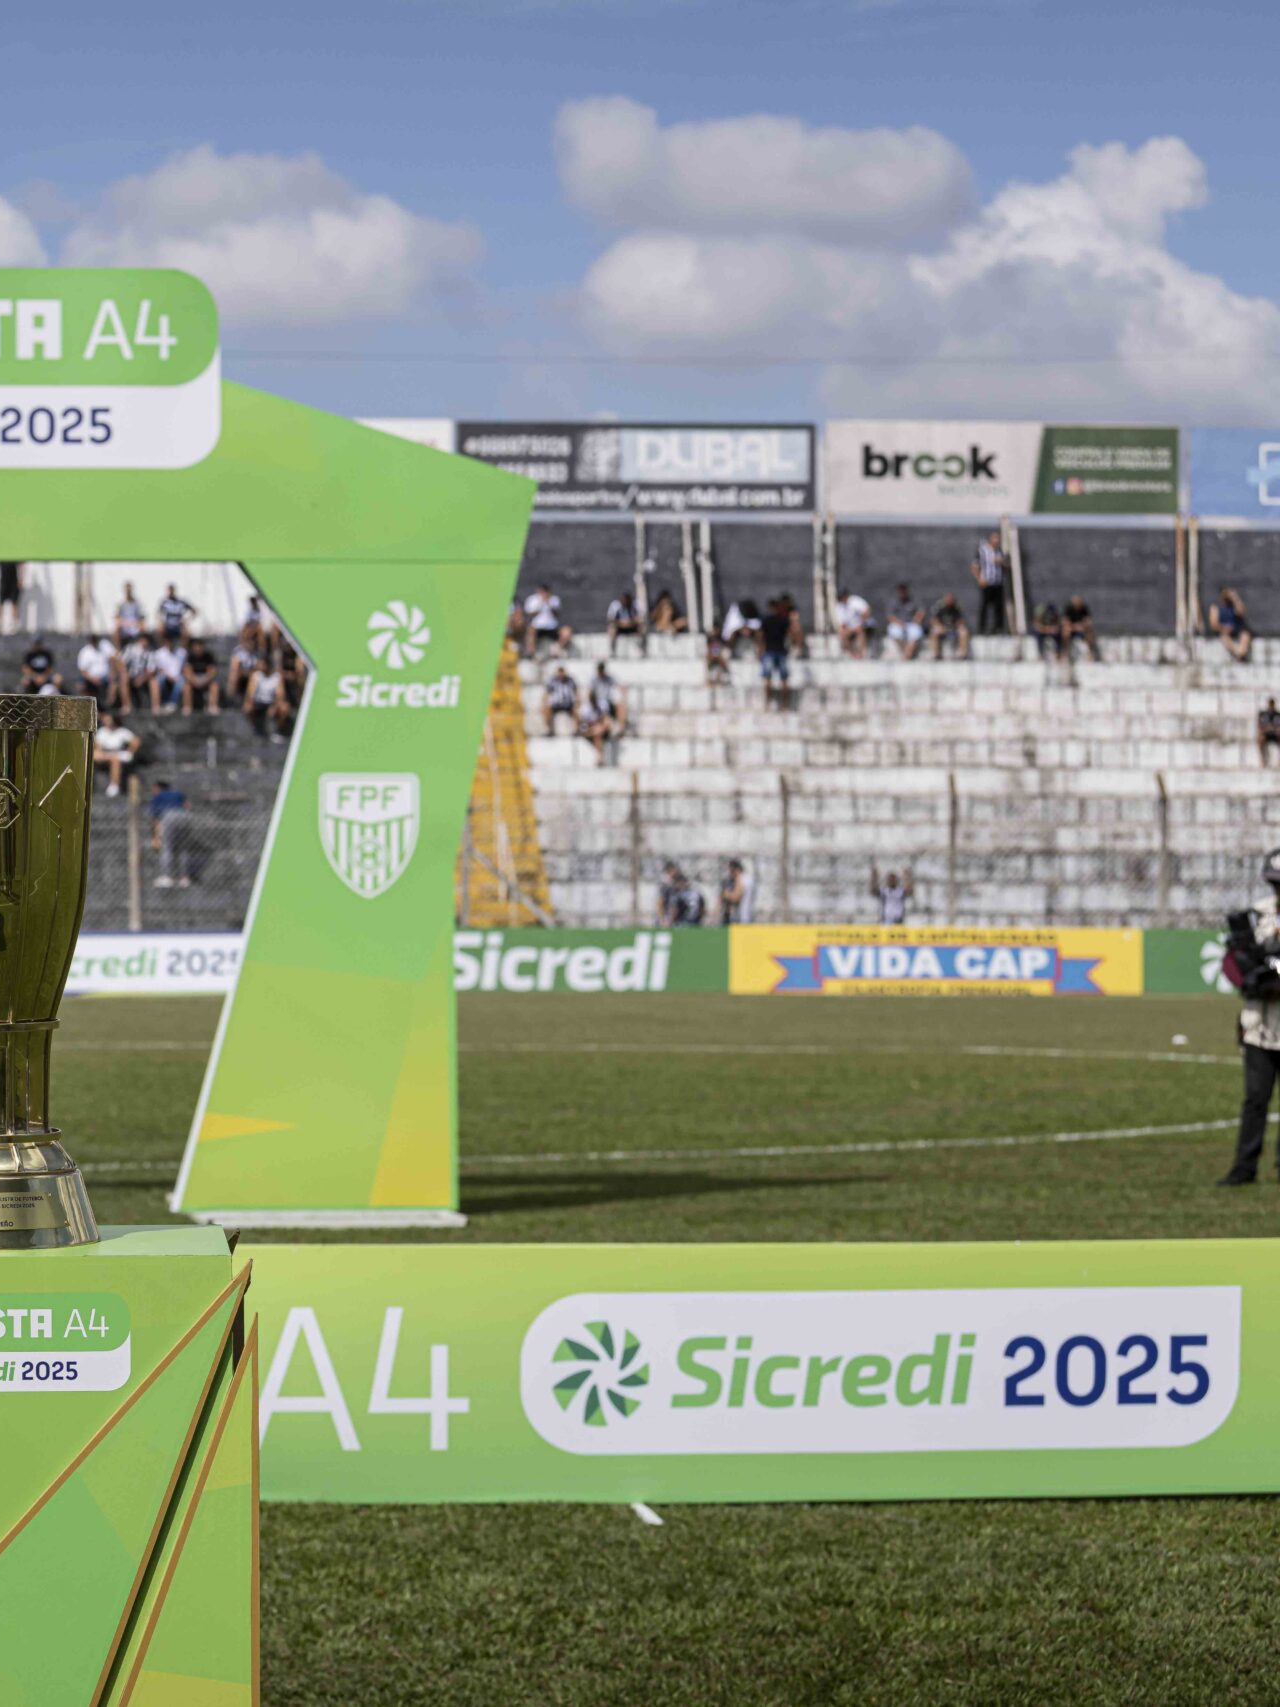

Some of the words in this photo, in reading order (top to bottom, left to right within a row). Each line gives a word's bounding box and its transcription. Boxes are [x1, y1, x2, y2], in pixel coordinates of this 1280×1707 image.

[83, 299, 178, 360] A4
[0, 407, 113, 444] 2025
[637, 430, 797, 474] DUBAL
[336, 675, 461, 707] Sicredi
[337, 785, 400, 811] FPF
[453, 931, 672, 992] Sicredi
[826, 945, 944, 979] VIDA
[953, 946, 1050, 979] CAP
[63, 1308, 110, 1339] A4
[21, 1360, 78, 1382] 2025
[259, 1306, 470, 1451] A4
[669, 1331, 976, 1409] Sicredi
[1002, 1334, 1211, 1407] 2025
